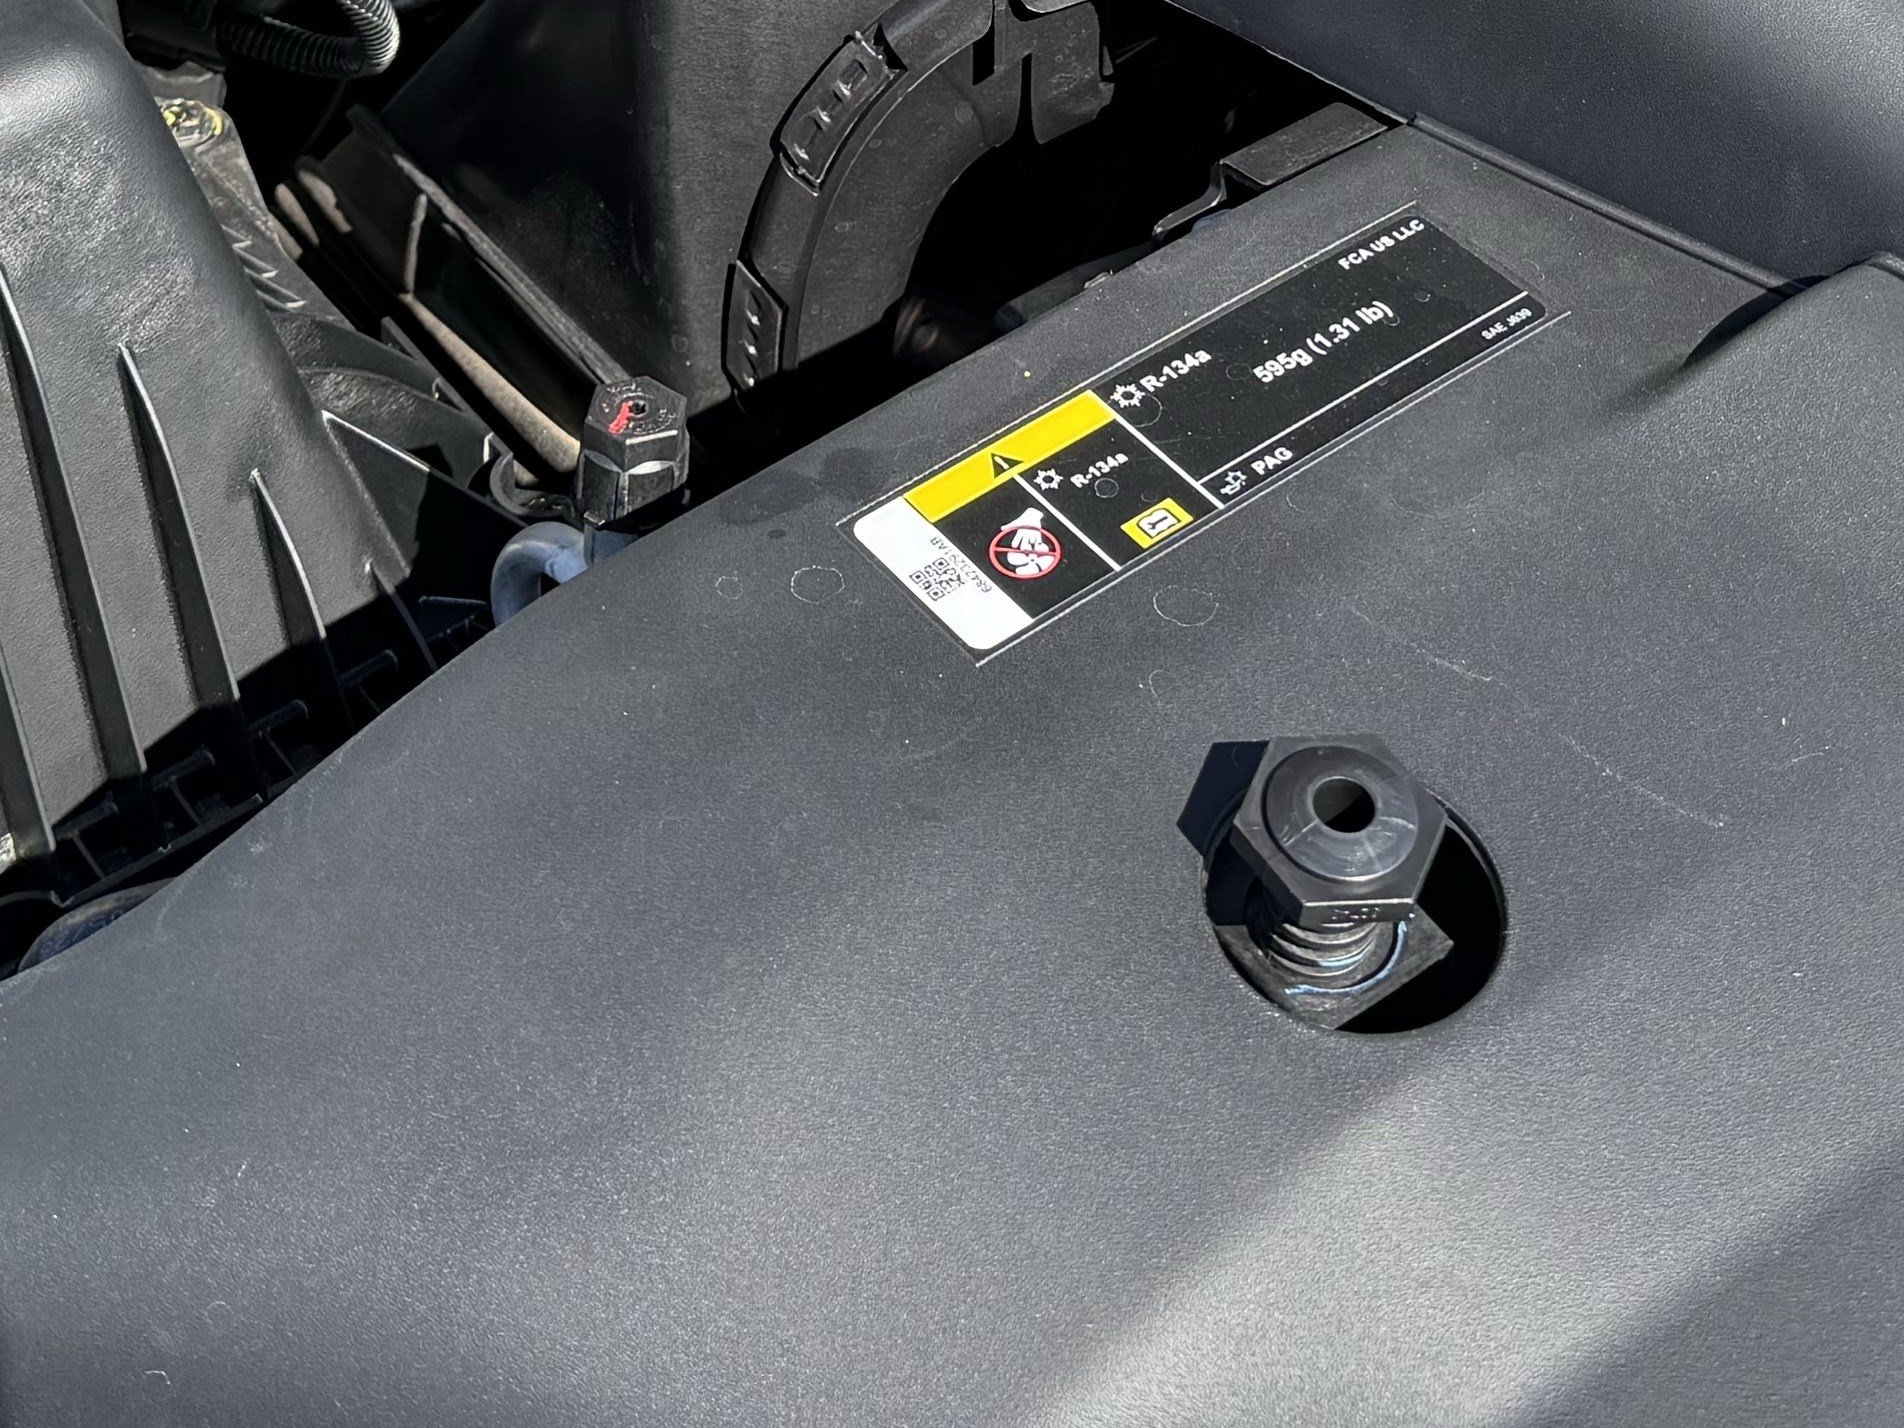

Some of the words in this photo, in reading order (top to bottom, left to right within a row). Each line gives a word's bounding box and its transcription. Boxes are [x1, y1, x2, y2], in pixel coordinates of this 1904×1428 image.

[1338, 248, 1374, 270] FCA
[1369, 235, 1395, 253] US
[1392, 219, 1425, 241] LLC
[1253, 348, 1313, 383] 595g
[1305, 317, 1360, 355] (1.31
[1355, 300, 1394, 325] lb)
[1481, 321, 1508, 340] SAE
[1139, 349, 1212, 392] R-134a
[1070, 452, 1129, 488] R-134a
[1250, 446, 1294, 475] PAG
